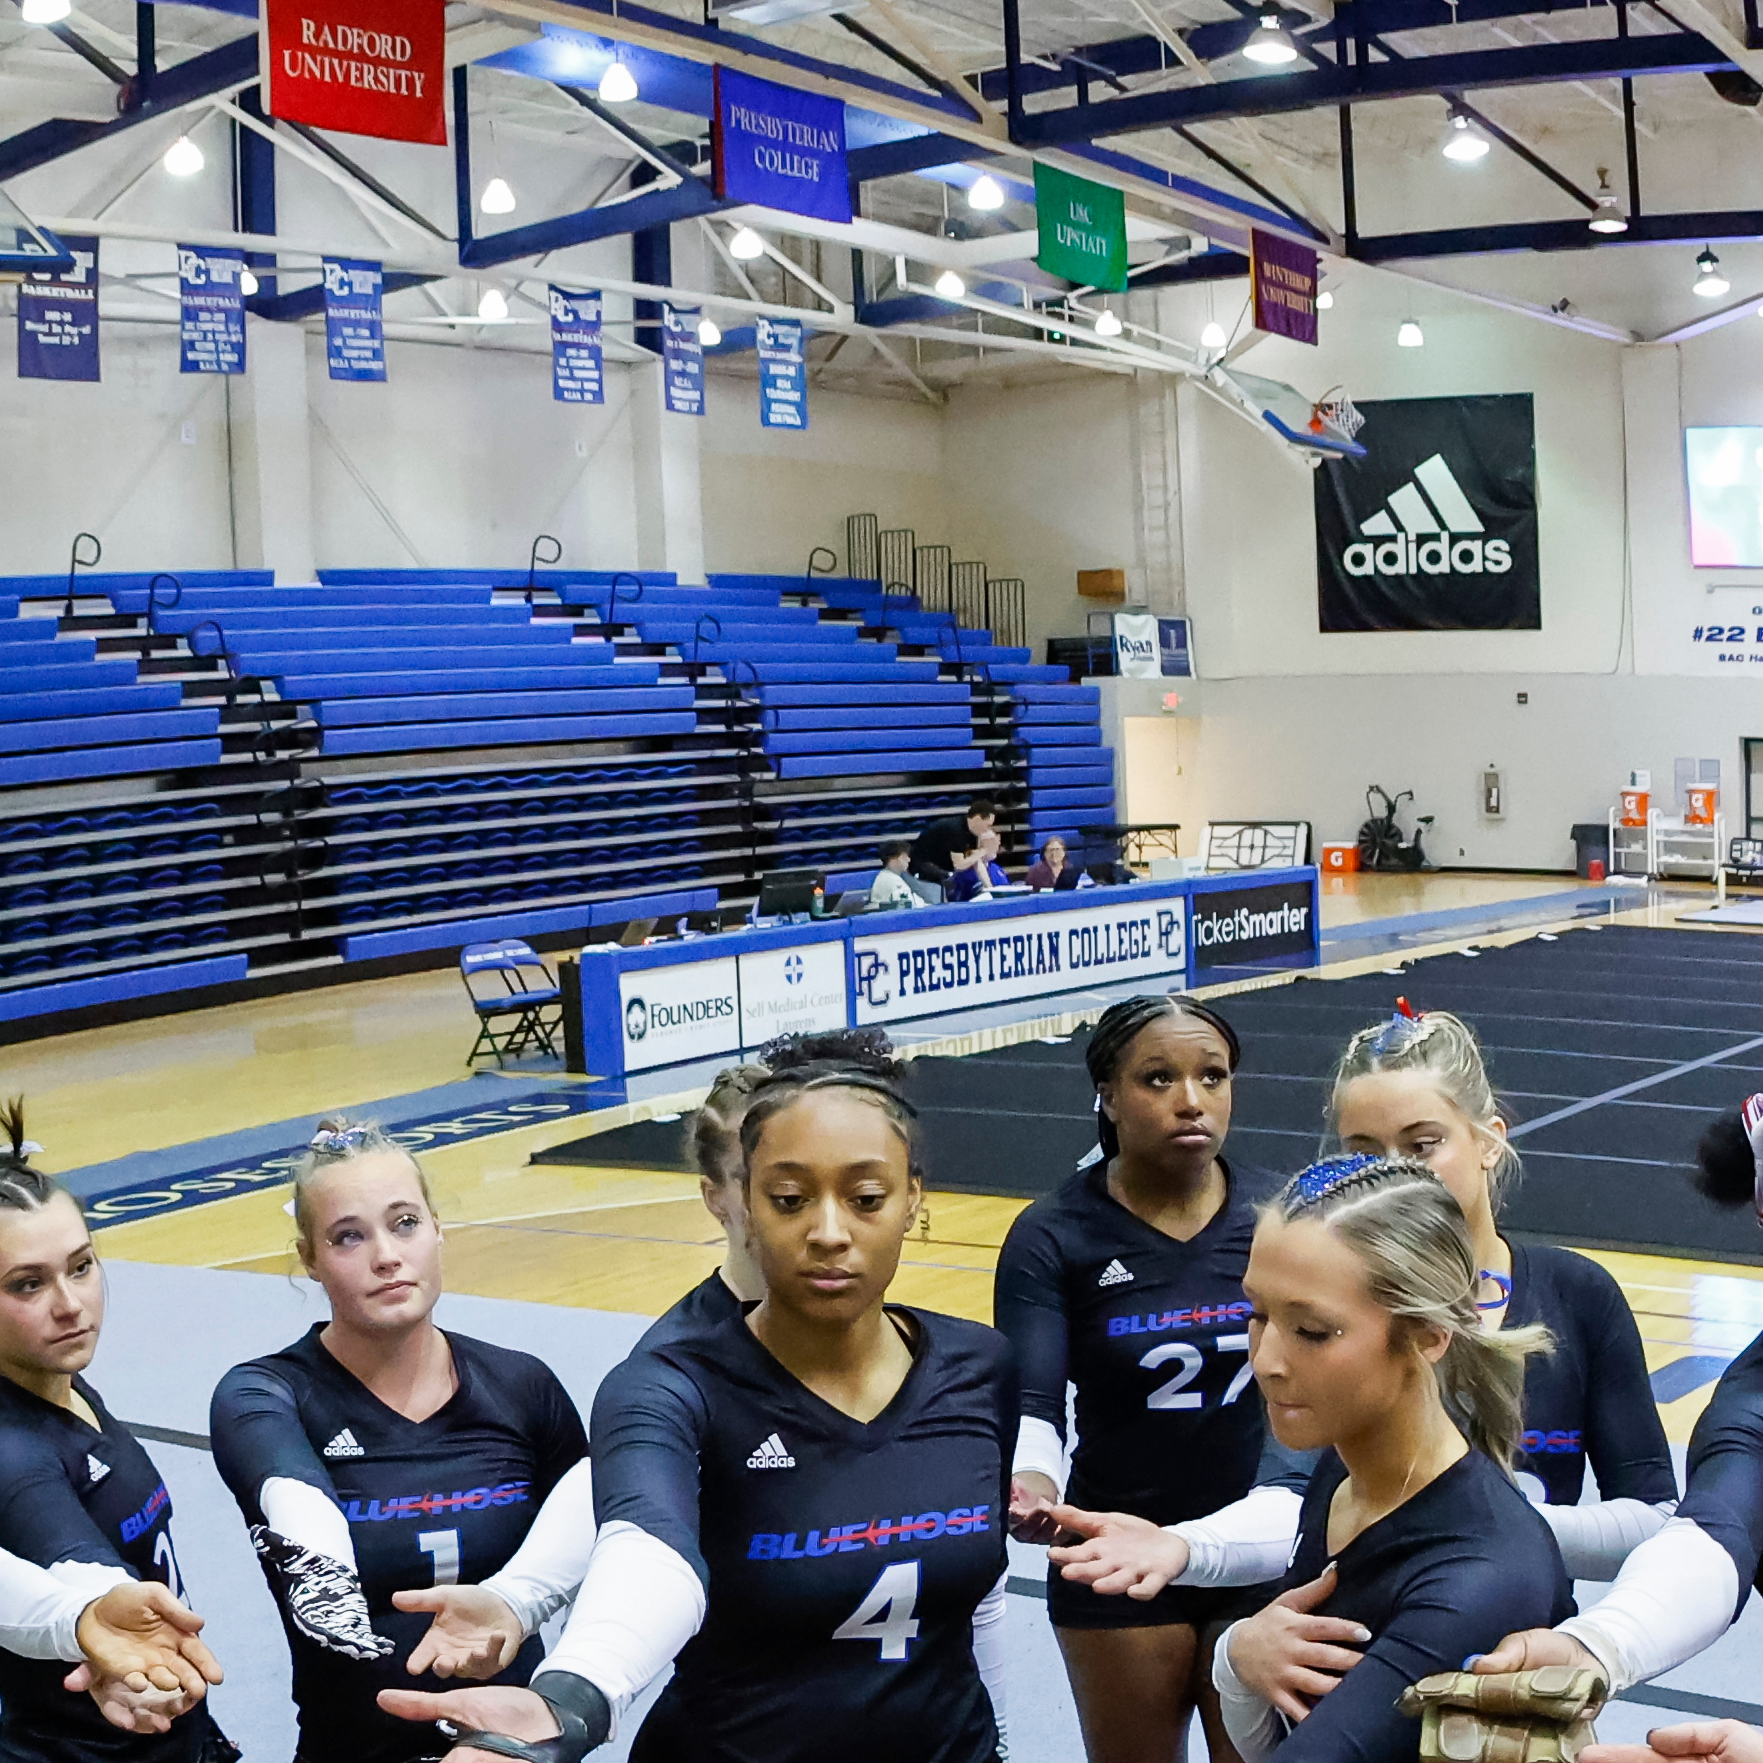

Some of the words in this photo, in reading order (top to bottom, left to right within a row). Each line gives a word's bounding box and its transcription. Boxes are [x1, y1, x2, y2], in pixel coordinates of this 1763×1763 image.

[301, 16, 412, 61] RADFORD
[283, 48, 426, 99] UNIVERSITY
[731, 104, 838, 152] PRESBYTERIAN
[754, 145, 820, 182] COLLEGE
[1342, 531, 1513, 577] adidas
[1692, 625, 1746, 643] #22
[1330, 851, 1343, 867] G
[1192, 904, 1309, 949] TicketSmarter
[855, 950, 890, 1008] PC
[897, 930, 1061, 997] PRESBYTERIAN
[1068, 918, 1152, 970] COLLEGE
[1156, 909, 1182, 959] PC
[650, 995, 735, 1031] FOUNDERS
[767, 996, 809, 1016] Medical
[810, 991, 844, 1008] Center
[1098, 1271, 1135, 1287] adidas
[1107, 1307, 1193, 1338] BLUE
[1138, 1332, 1255, 1411] 27
[323, 1446, 365, 1457] adidas
[1520, 1429, 1581, 1454] OSE
[746, 1455, 796, 1469] adidas
[341, 1494, 423, 1533] LUE
[746, 1521, 869, 1561] BLUE
[878, 1503, 991, 1547] HOSE
[831, 1558, 923, 1663] 4
